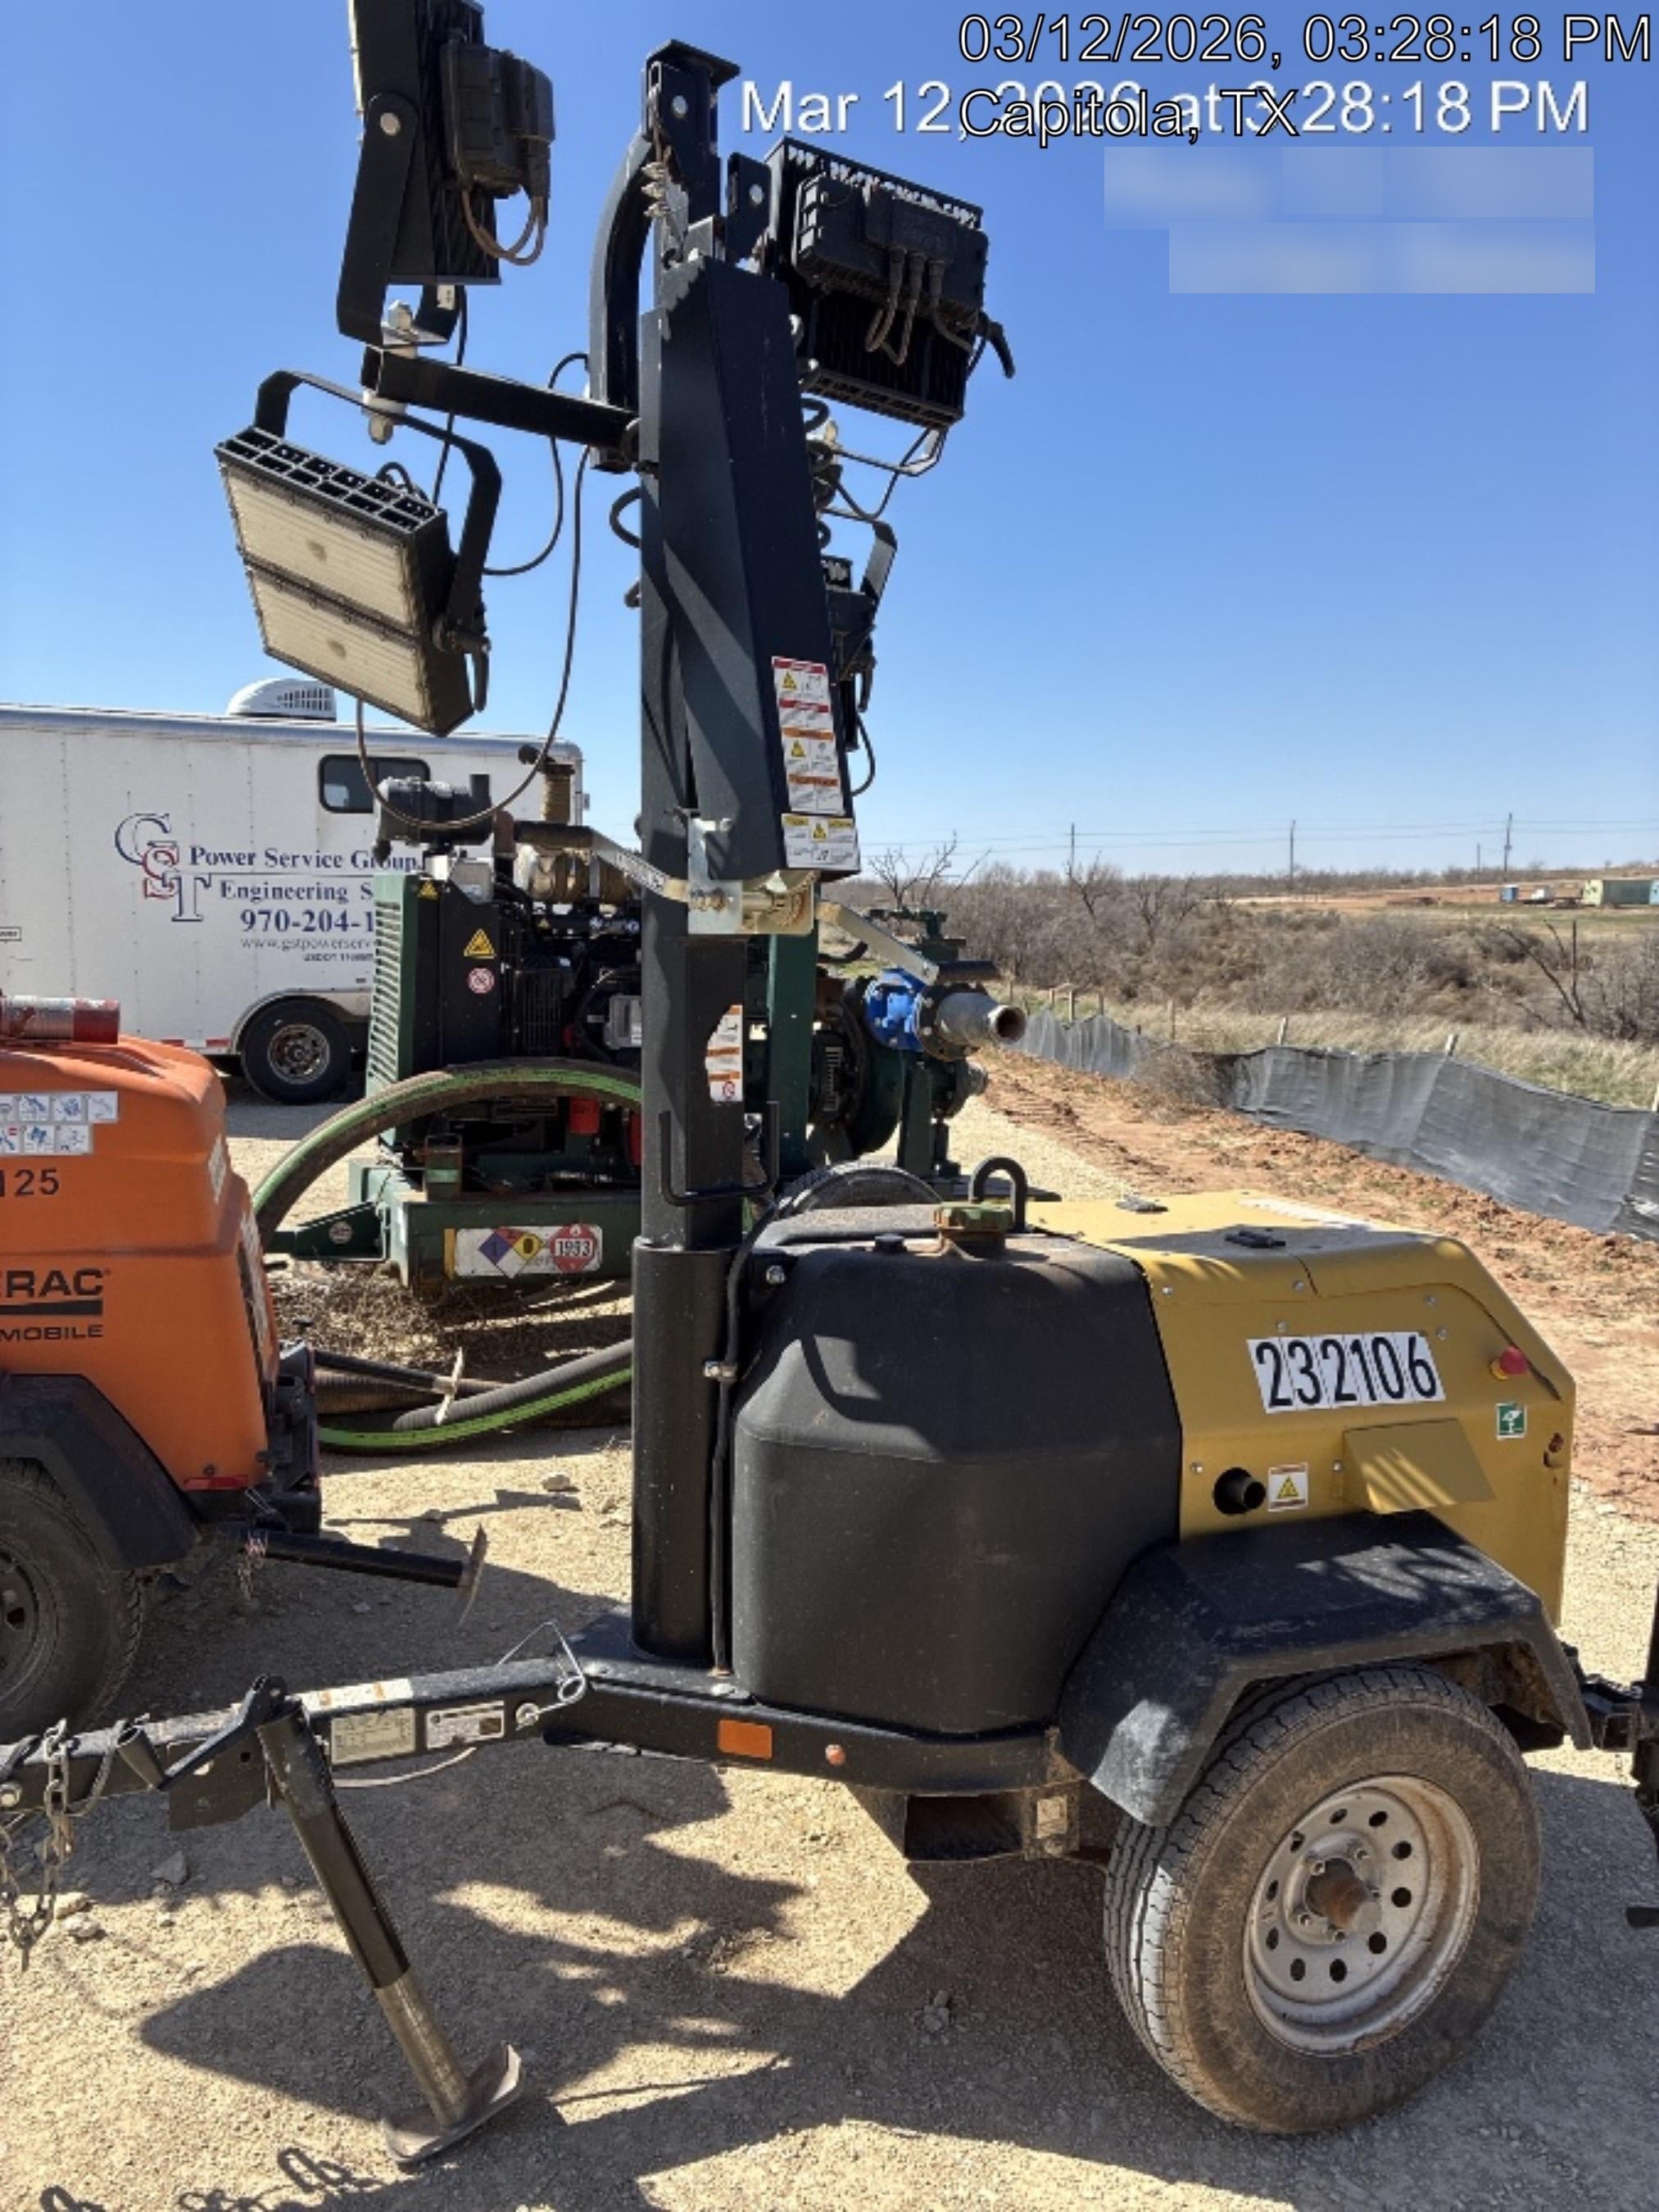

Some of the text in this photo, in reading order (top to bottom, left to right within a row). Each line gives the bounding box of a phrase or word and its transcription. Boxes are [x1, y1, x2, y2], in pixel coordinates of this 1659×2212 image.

[189, 845, 256, 867] Power
[265, 848, 343, 868] Service
[220, 880, 349, 904] Engineering
[0, 1268, 103, 1299] RAC
[1255, 1336, 1436, 1407] 232106
